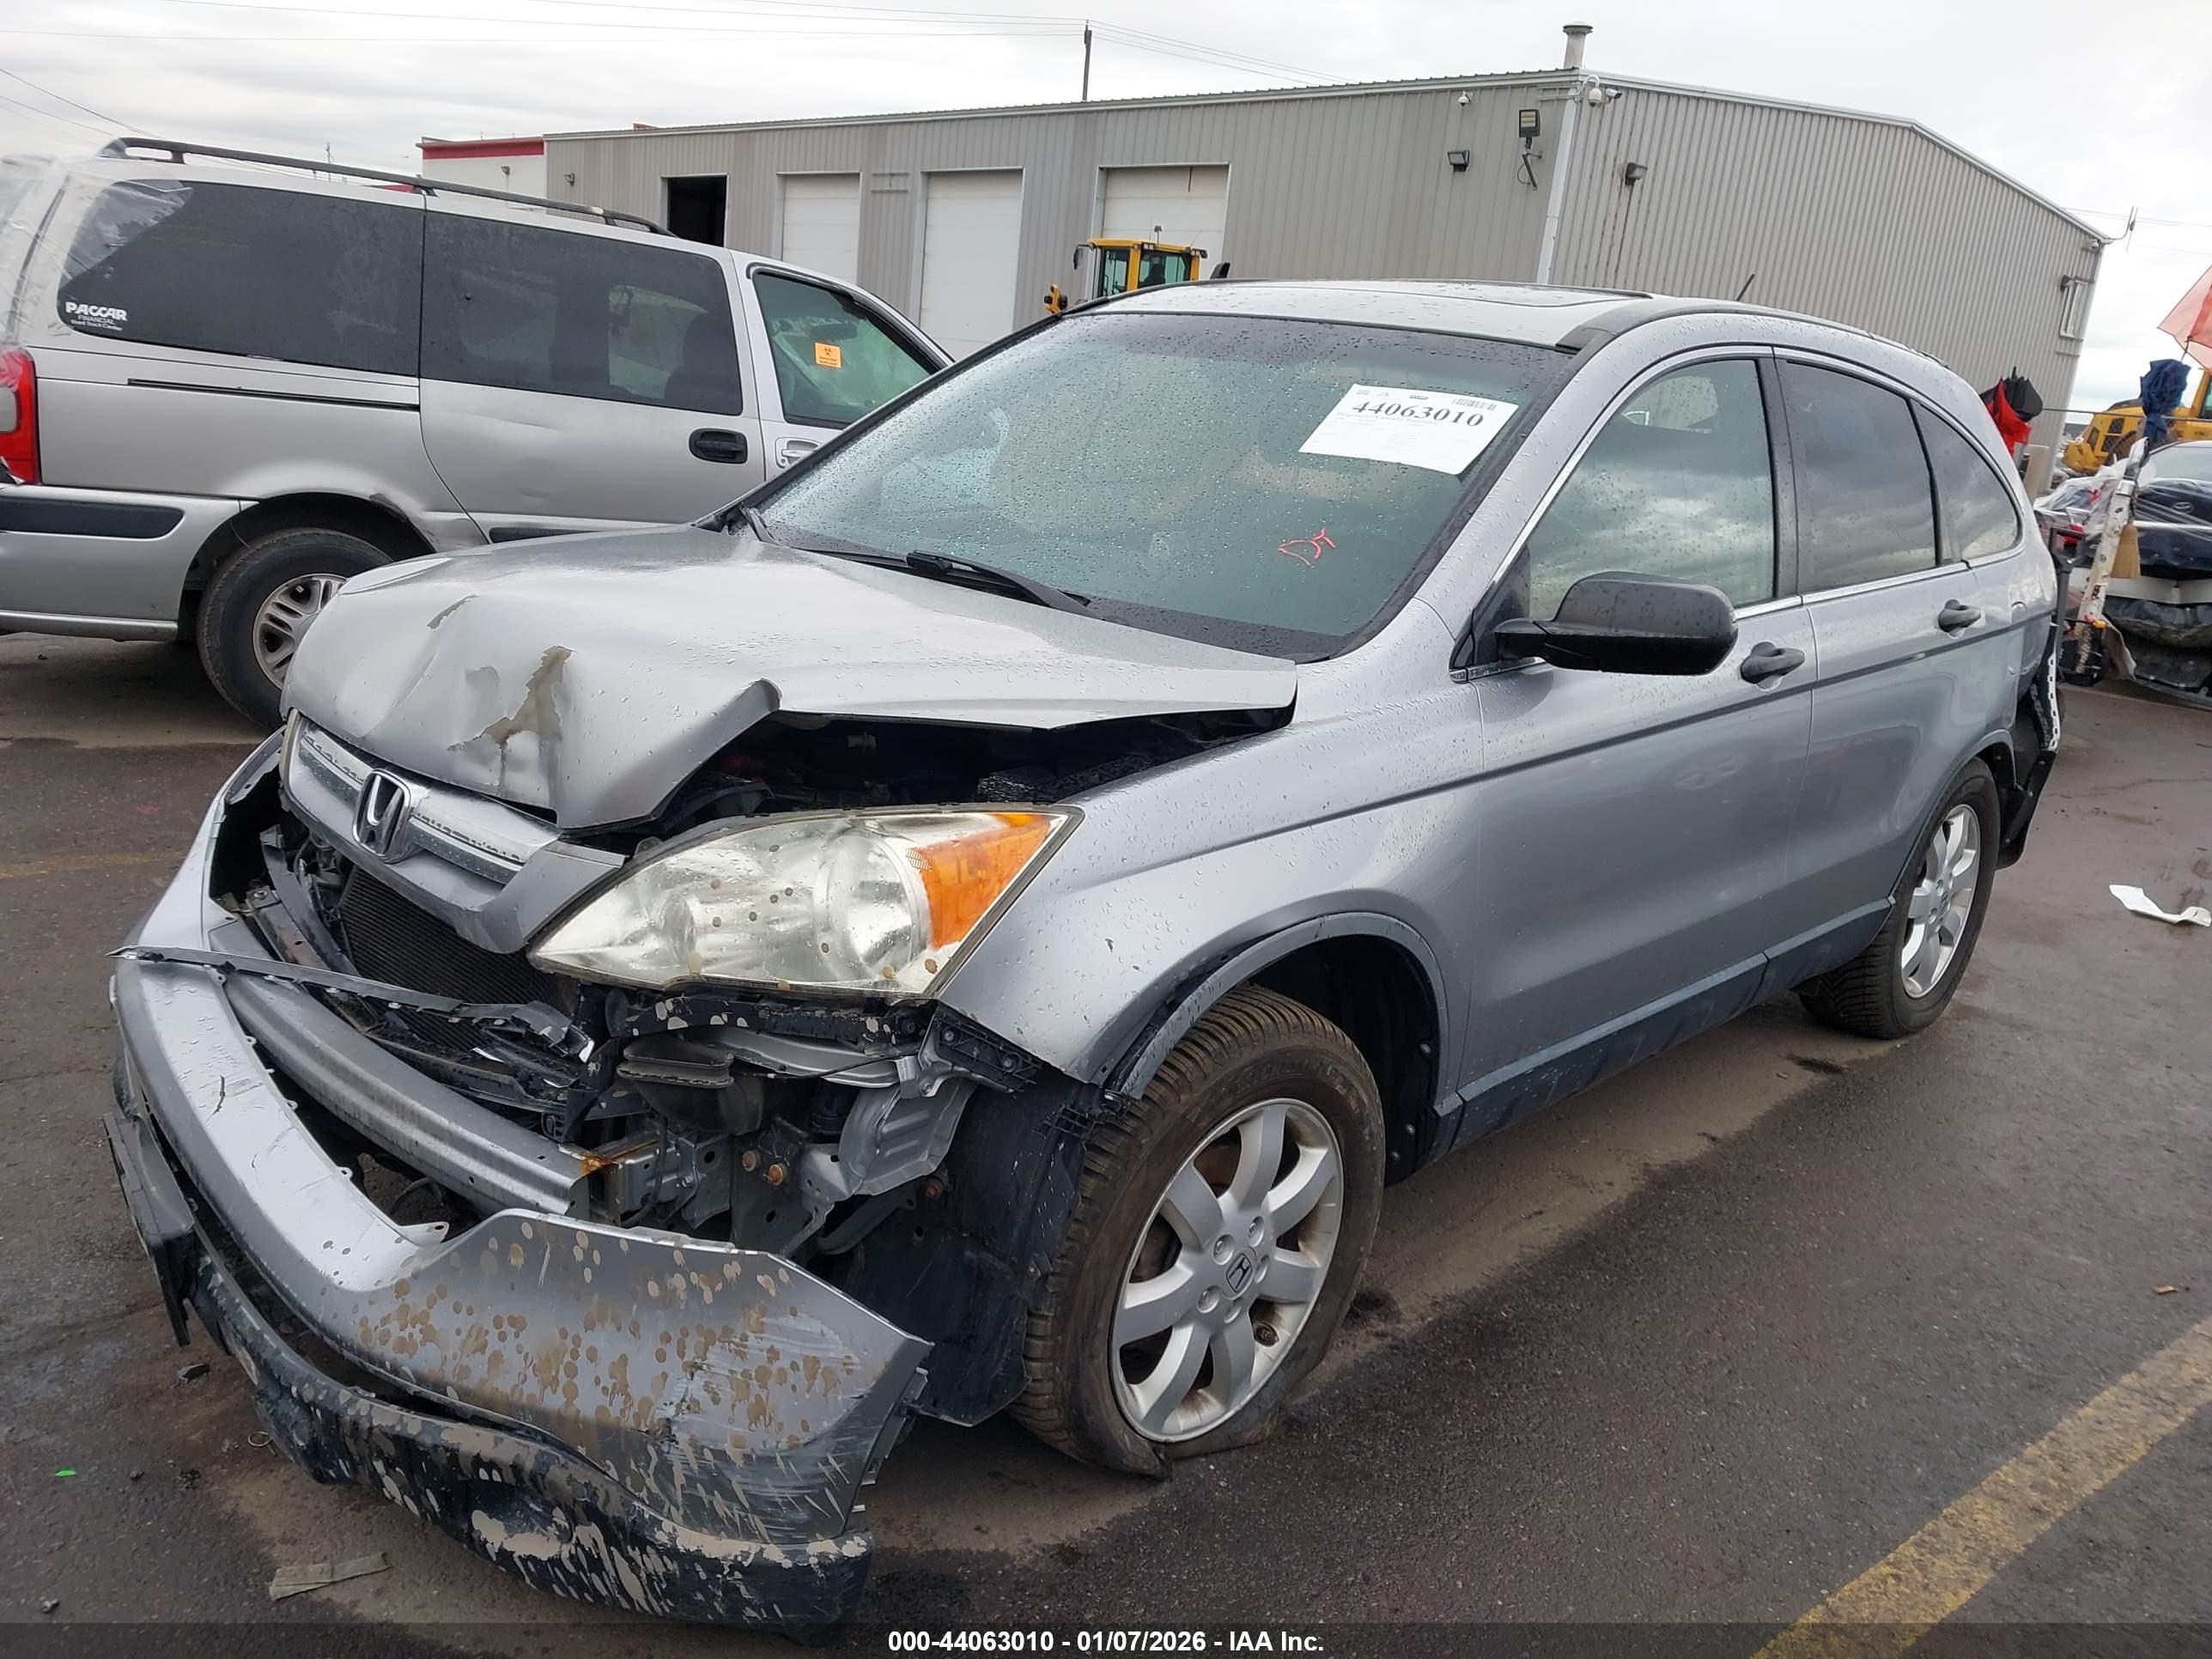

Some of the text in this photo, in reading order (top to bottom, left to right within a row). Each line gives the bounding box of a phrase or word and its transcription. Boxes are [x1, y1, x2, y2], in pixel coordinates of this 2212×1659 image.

[65, 301, 127, 321] PACCAR
[78, 314, 115, 325] FINANCIAL
[1352, 400, 1484, 427] 44063010
